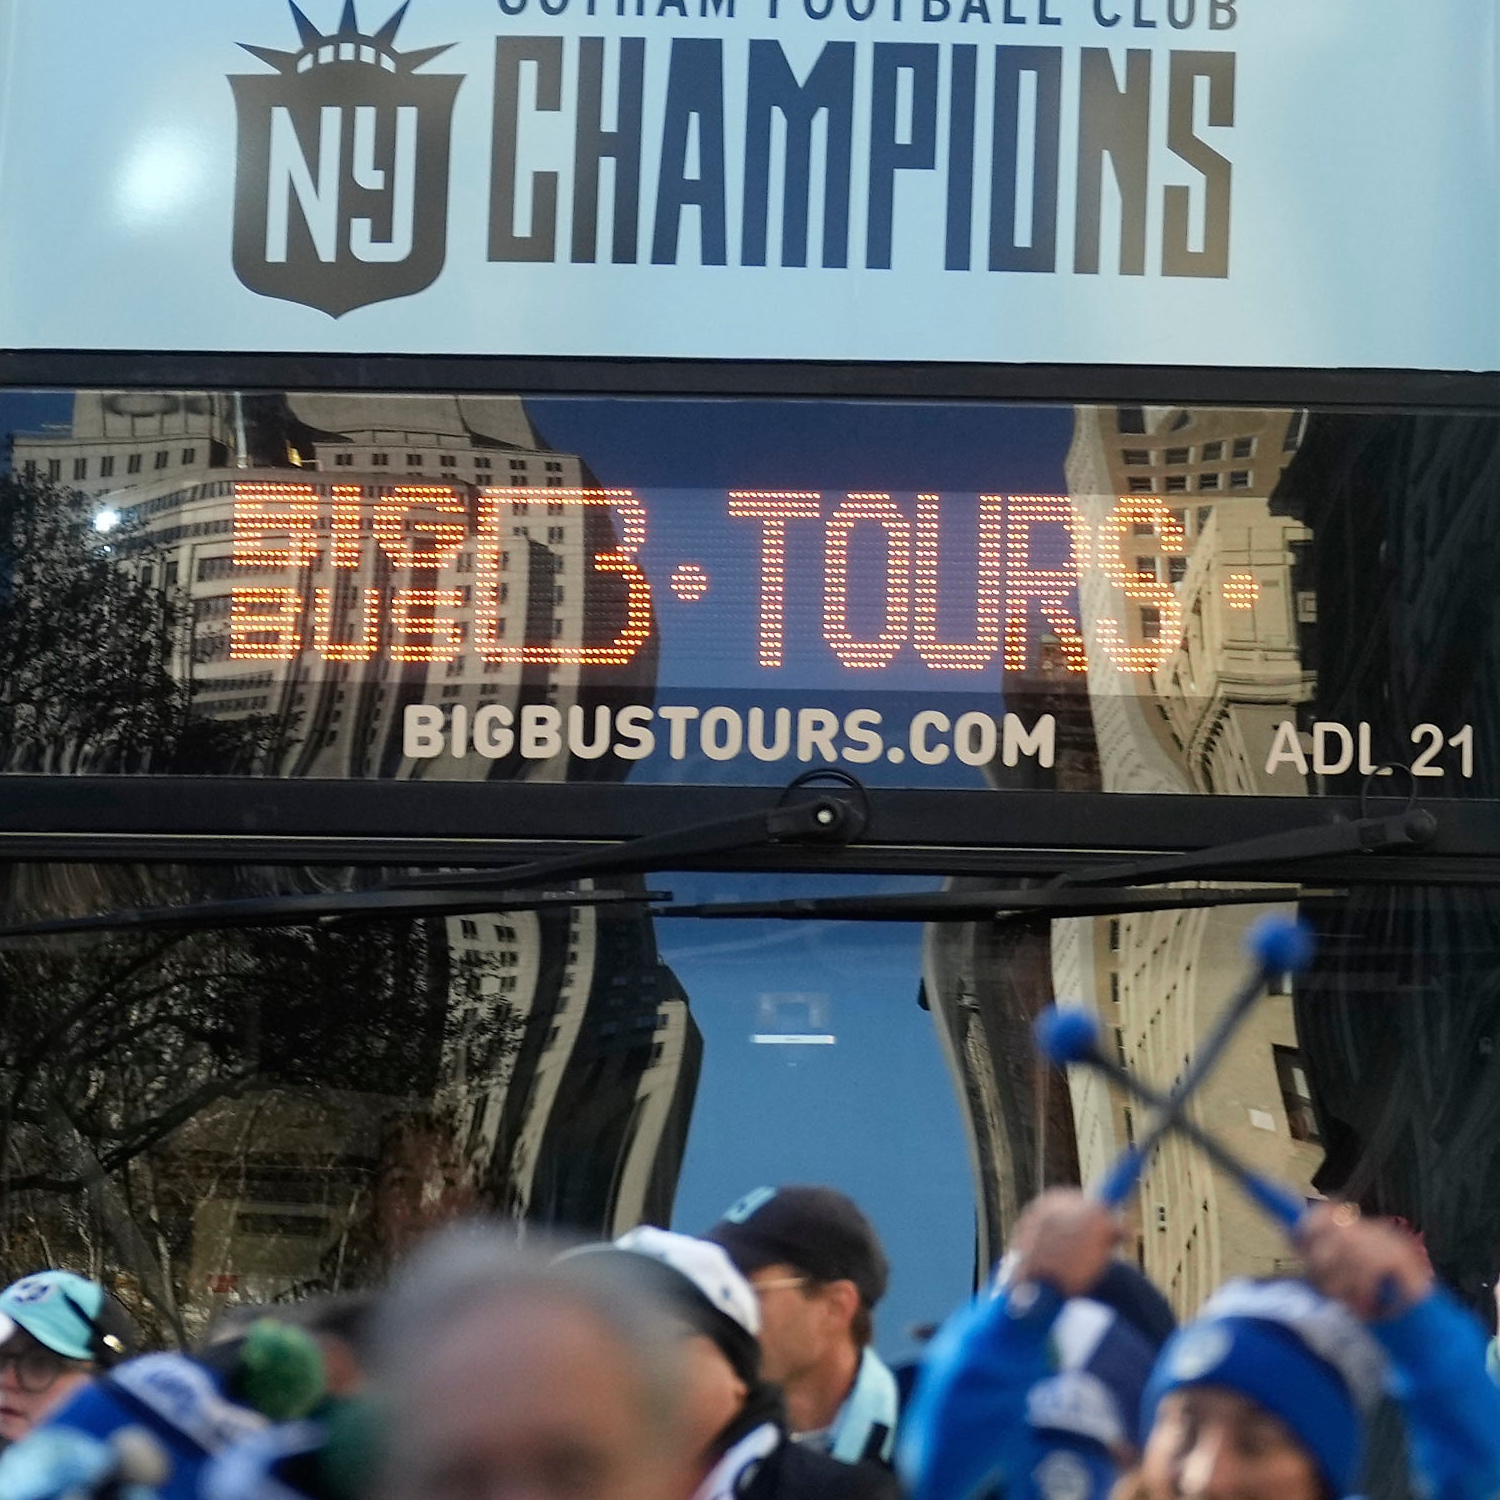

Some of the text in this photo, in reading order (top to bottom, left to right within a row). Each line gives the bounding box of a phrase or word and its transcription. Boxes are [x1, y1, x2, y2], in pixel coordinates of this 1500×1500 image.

[264, 106, 418, 263] NY
[486, 35, 1236, 279] CHAMPIONS
[233, 484, 466, 568] BIG
[230, 586, 463, 662] BUS
[728, 491, 1184, 673] TOURS
[403, 705, 1055, 768] BIGBUSTOURS.COM
[1264, 720, 1474, 778] ADL 21
